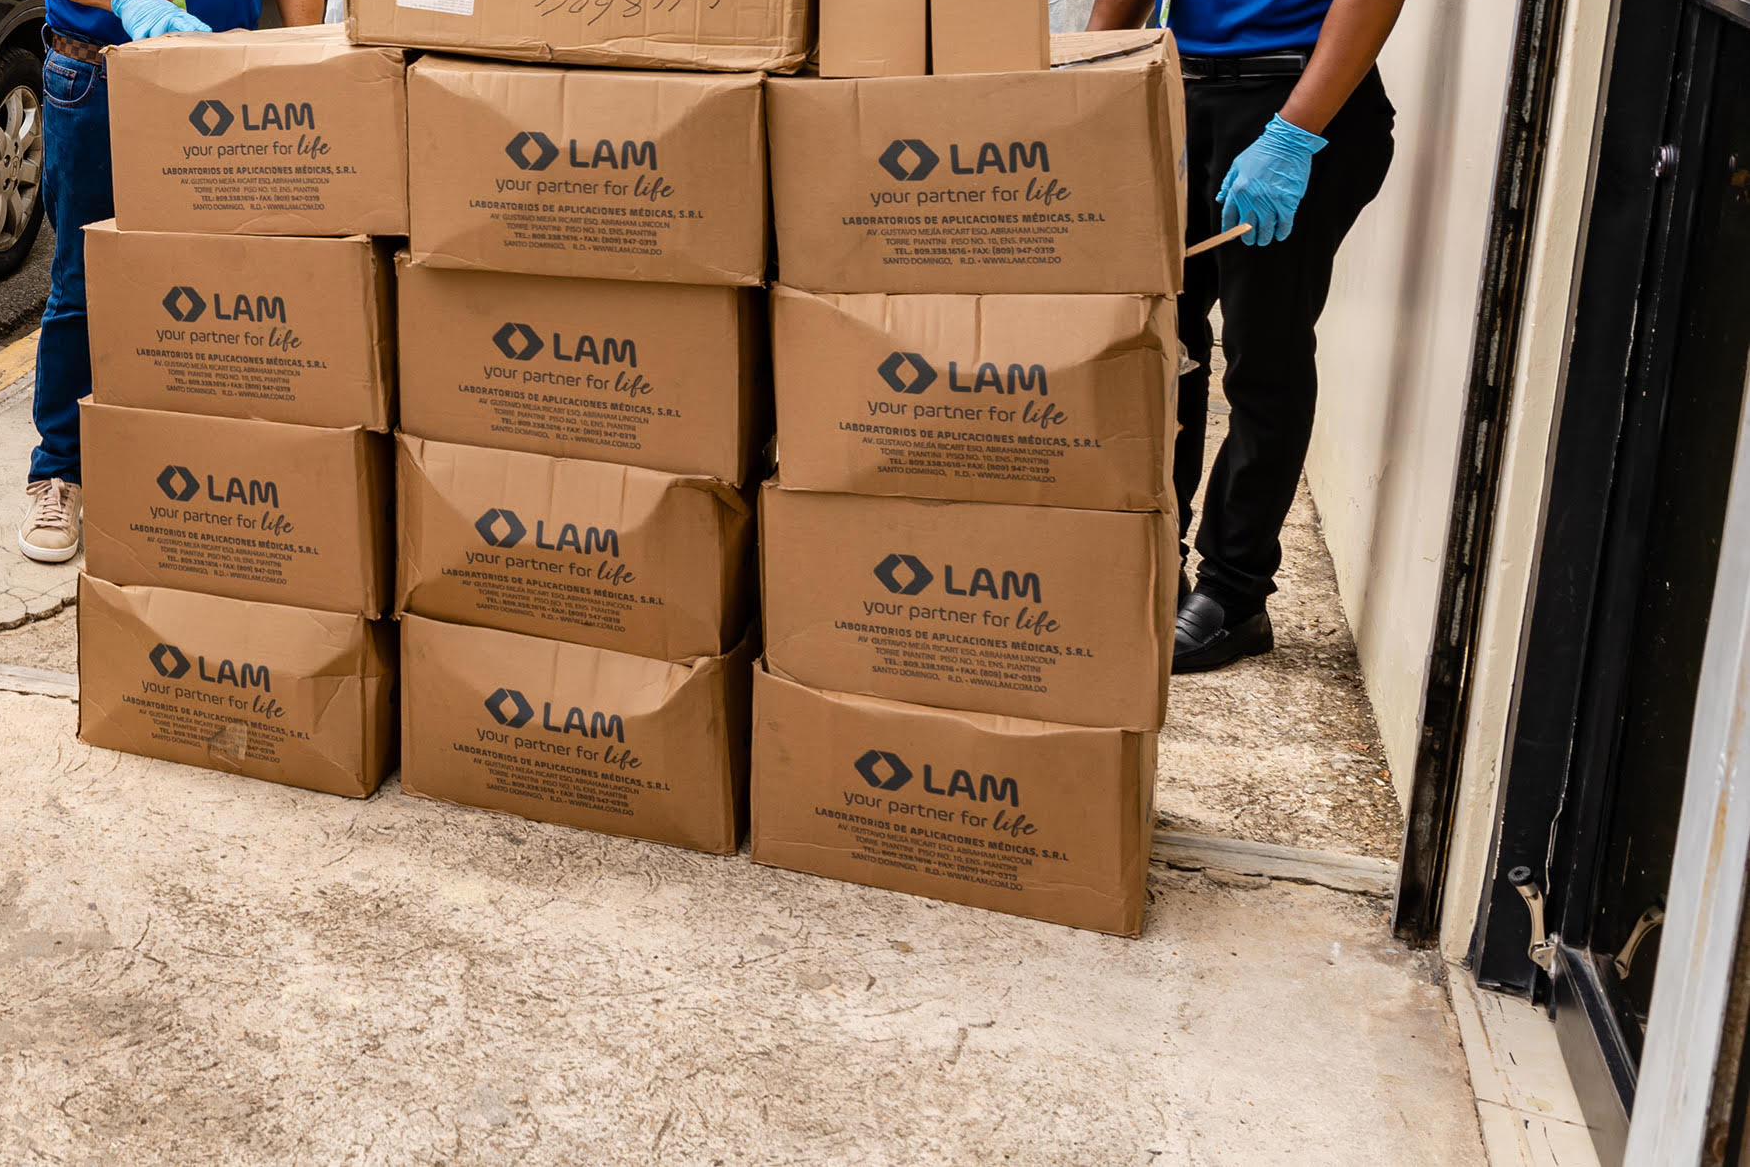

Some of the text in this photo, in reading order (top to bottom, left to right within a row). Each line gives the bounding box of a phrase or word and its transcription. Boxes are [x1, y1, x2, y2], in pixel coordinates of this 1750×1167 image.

[241, 103, 315, 131] LAM
[183, 134, 331, 159] your partner for life
[569, 139, 657, 170] LAM
[950, 141, 1049, 175] LAM
[162, 167, 221, 175] LABORATORIOS
[223, 167, 234, 175] DE
[236, 166, 293, 175] APLICACIONES
[495, 174, 675, 202] your partner for life
[870, 177, 1071, 207] your partner for life
[469, 200, 540, 212] LABORATORIOS
[542, 204, 555, 213] DE
[558, 205, 626, 216] APLICACIONES
[842, 216, 921, 225] LABORATORIOS
[924, 216, 938, 225] DE
[941, 214, 1018, 224] APLICACIONES
[883, 257, 910, 265] SANTO
[214, 294, 286, 323] LAM
[156, 327, 302, 352] your partner for life
[553, 333, 637, 368] LAM
[136, 348, 193, 359] LABORATORIOS
[195, 352, 206, 361] DE
[208, 354, 264, 364] APLICACIONES
[483, 366, 654, 398] your partner for life
[948, 361, 1048, 396] LAM
[459, 385, 525, 399] LABORATORIOS
[527, 393, 539, 402] DE
[542, 395, 607, 409] APLICACIONES
[867, 400, 1068, 429] your partner for life
[838, 423, 917, 436] LABORATORIOS
[920, 429, 934, 438] DE
[937, 430, 1014, 443] APLICACIONES
[207, 475, 279, 508] LAM
[150, 506, 294, 536] your partner for life
[535, 520, 620, 557] LAM
[441, 566, 509, 582] LABORATORIOS
[511, 576, 523, 585] DE
[526, 579, 590, 595] APLICACIONES
[467, 550, 636, 585] your partner for life
[944, 565, 1041, 603] LAM
[863, 601, 1061, 636] your partner for life
[834, 621, 912, 638] LABORATORIOS
[915, 630, 928, 640] DE
[932, 633, 1007, 649] APLICACIONES
[198, 656, 270, 692] LAM
[141, 681, 286, 719] your partner for life
[542, 704, 625, 743] LAM
[476, 729, 642, 770] your partner for life
[923, 765, 1019, 807] LAM
[815, 809, 891, 830] LABORATORIOS
[893, 823, 907, 833] DE
[910, 827, 985, 847] APLICACIONES
[843, 792, 1038, 838] your partner for life
